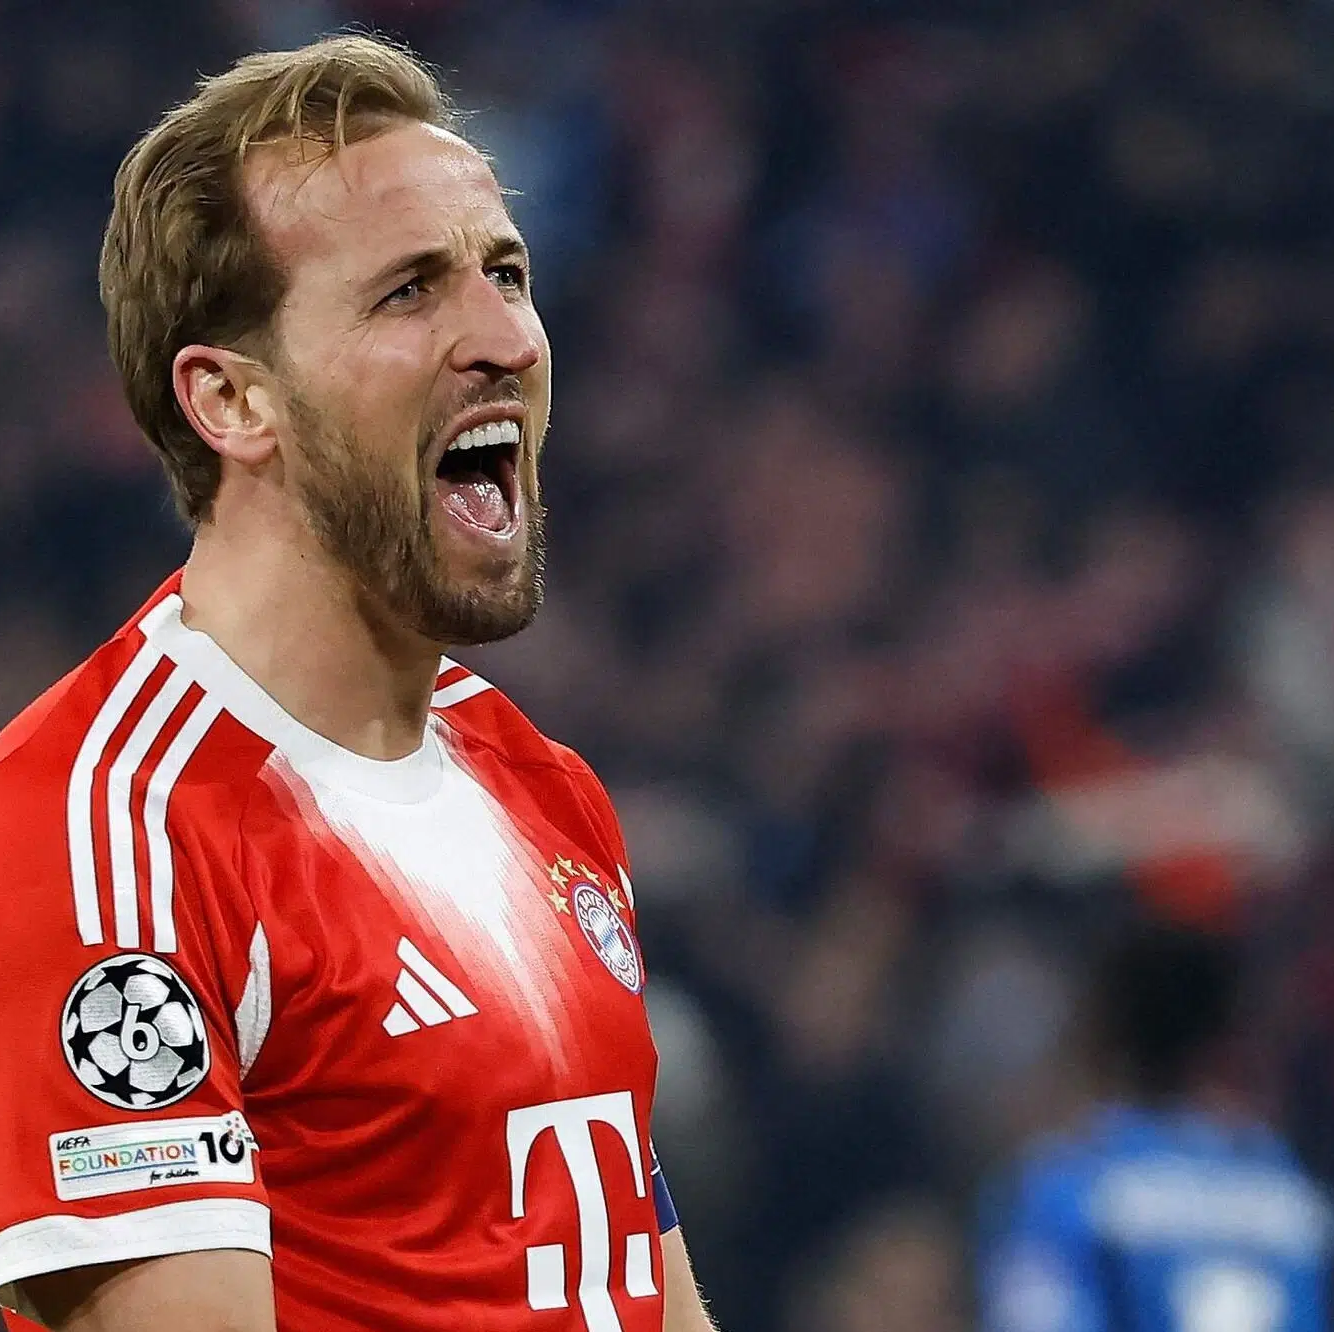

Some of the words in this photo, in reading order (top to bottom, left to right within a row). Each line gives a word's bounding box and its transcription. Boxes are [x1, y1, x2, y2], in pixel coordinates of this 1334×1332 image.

[120, 1002, 160, 1061] 6
[56, 1136, 92, 1152] UEFA
[58, 1143, 197, 1176] FOUNDATION
[199, 1131, 245, 1165] 10
[150, 1171, 162, 1185] for
